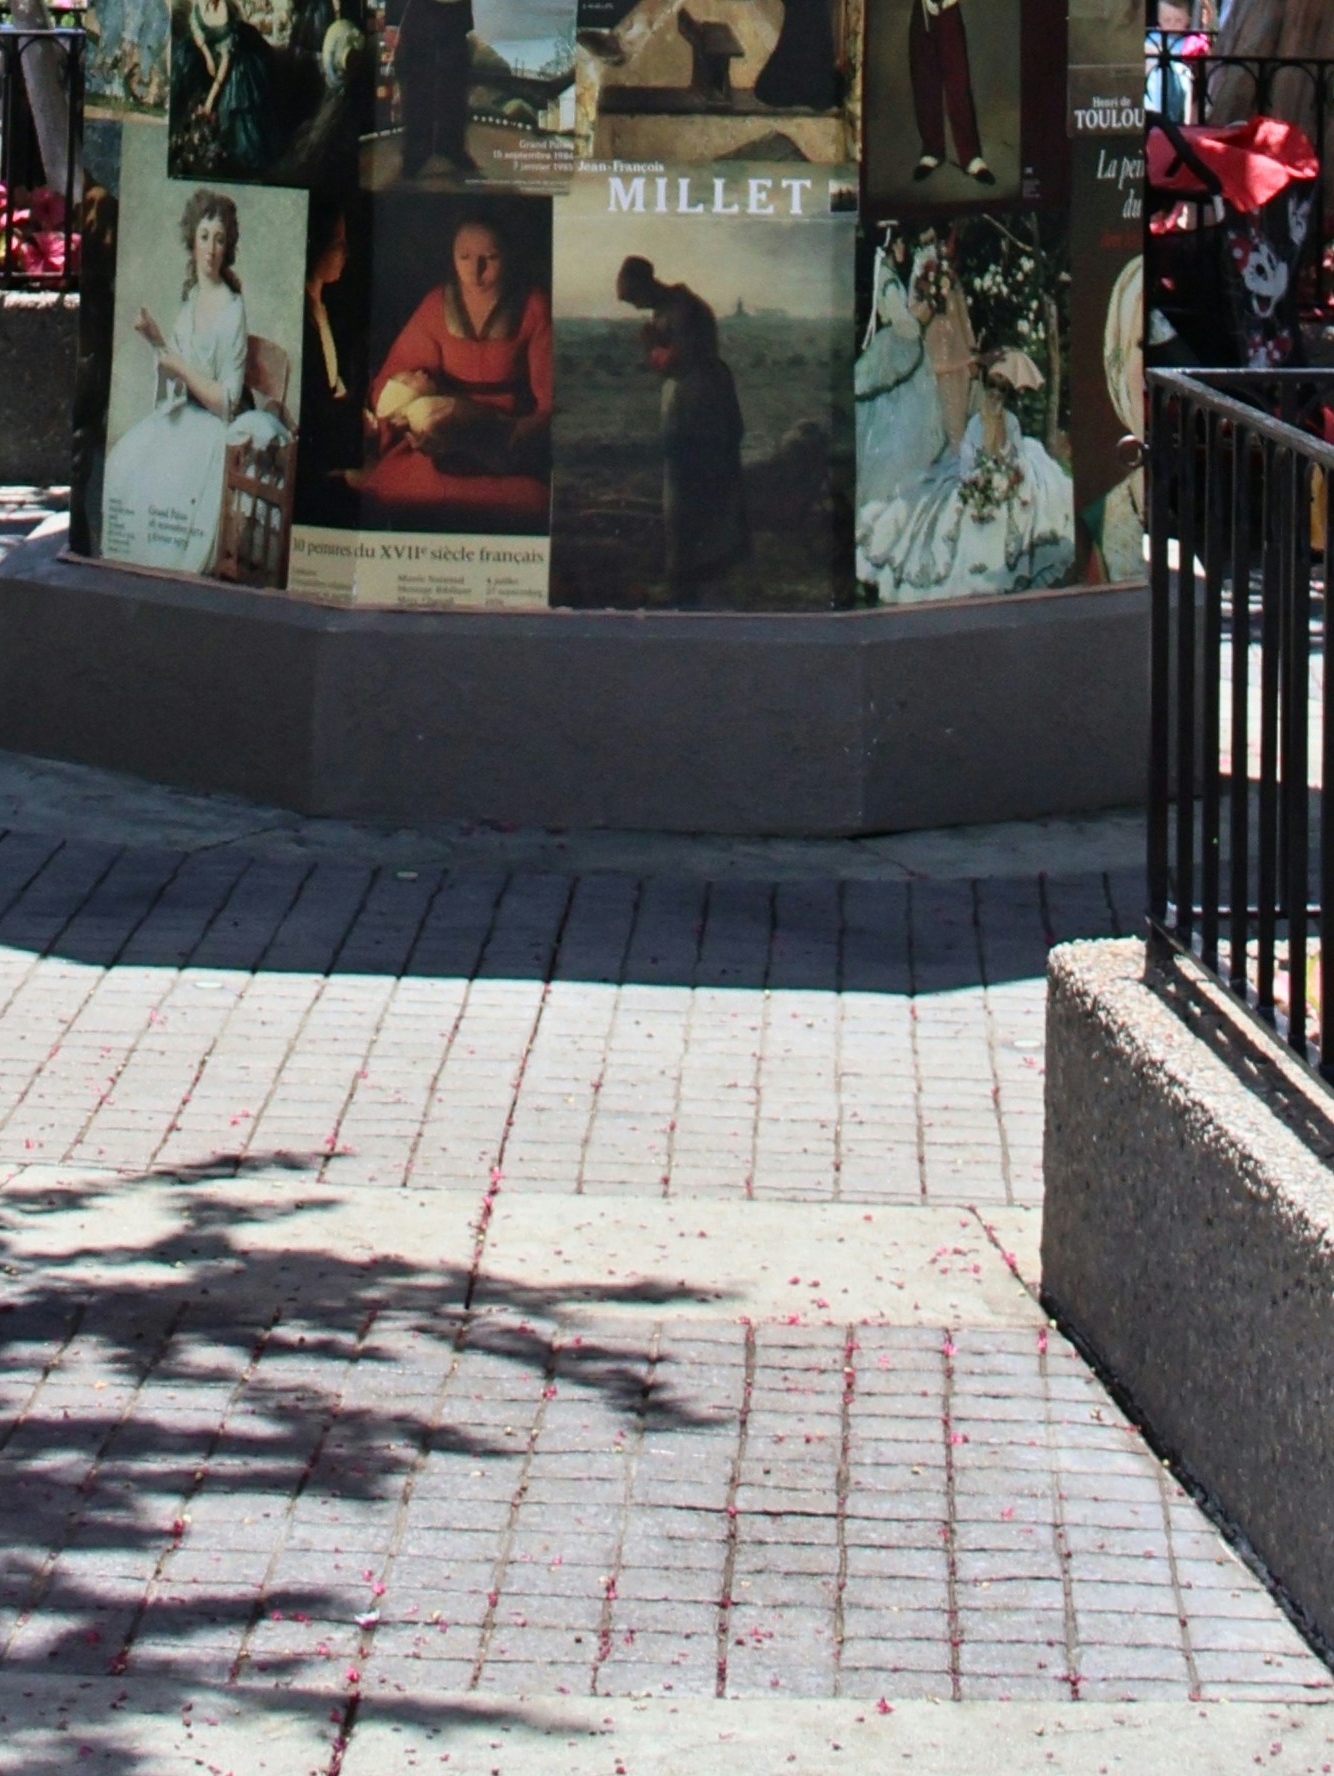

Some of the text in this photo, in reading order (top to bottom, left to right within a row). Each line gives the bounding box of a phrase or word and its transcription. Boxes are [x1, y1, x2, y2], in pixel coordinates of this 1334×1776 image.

[1092, 96, 1132, 108] Henri de
[578, 160, 665, 174] Jean-François
[1097, 148, 1118, 180] La
[608, 176, 812, 216] MILLET
[1122, 188, 1143, 219] du
[354, 541, 376, 559] du
[430, 543, 475, 563] siècle
[479, 544, 546, 565] français
